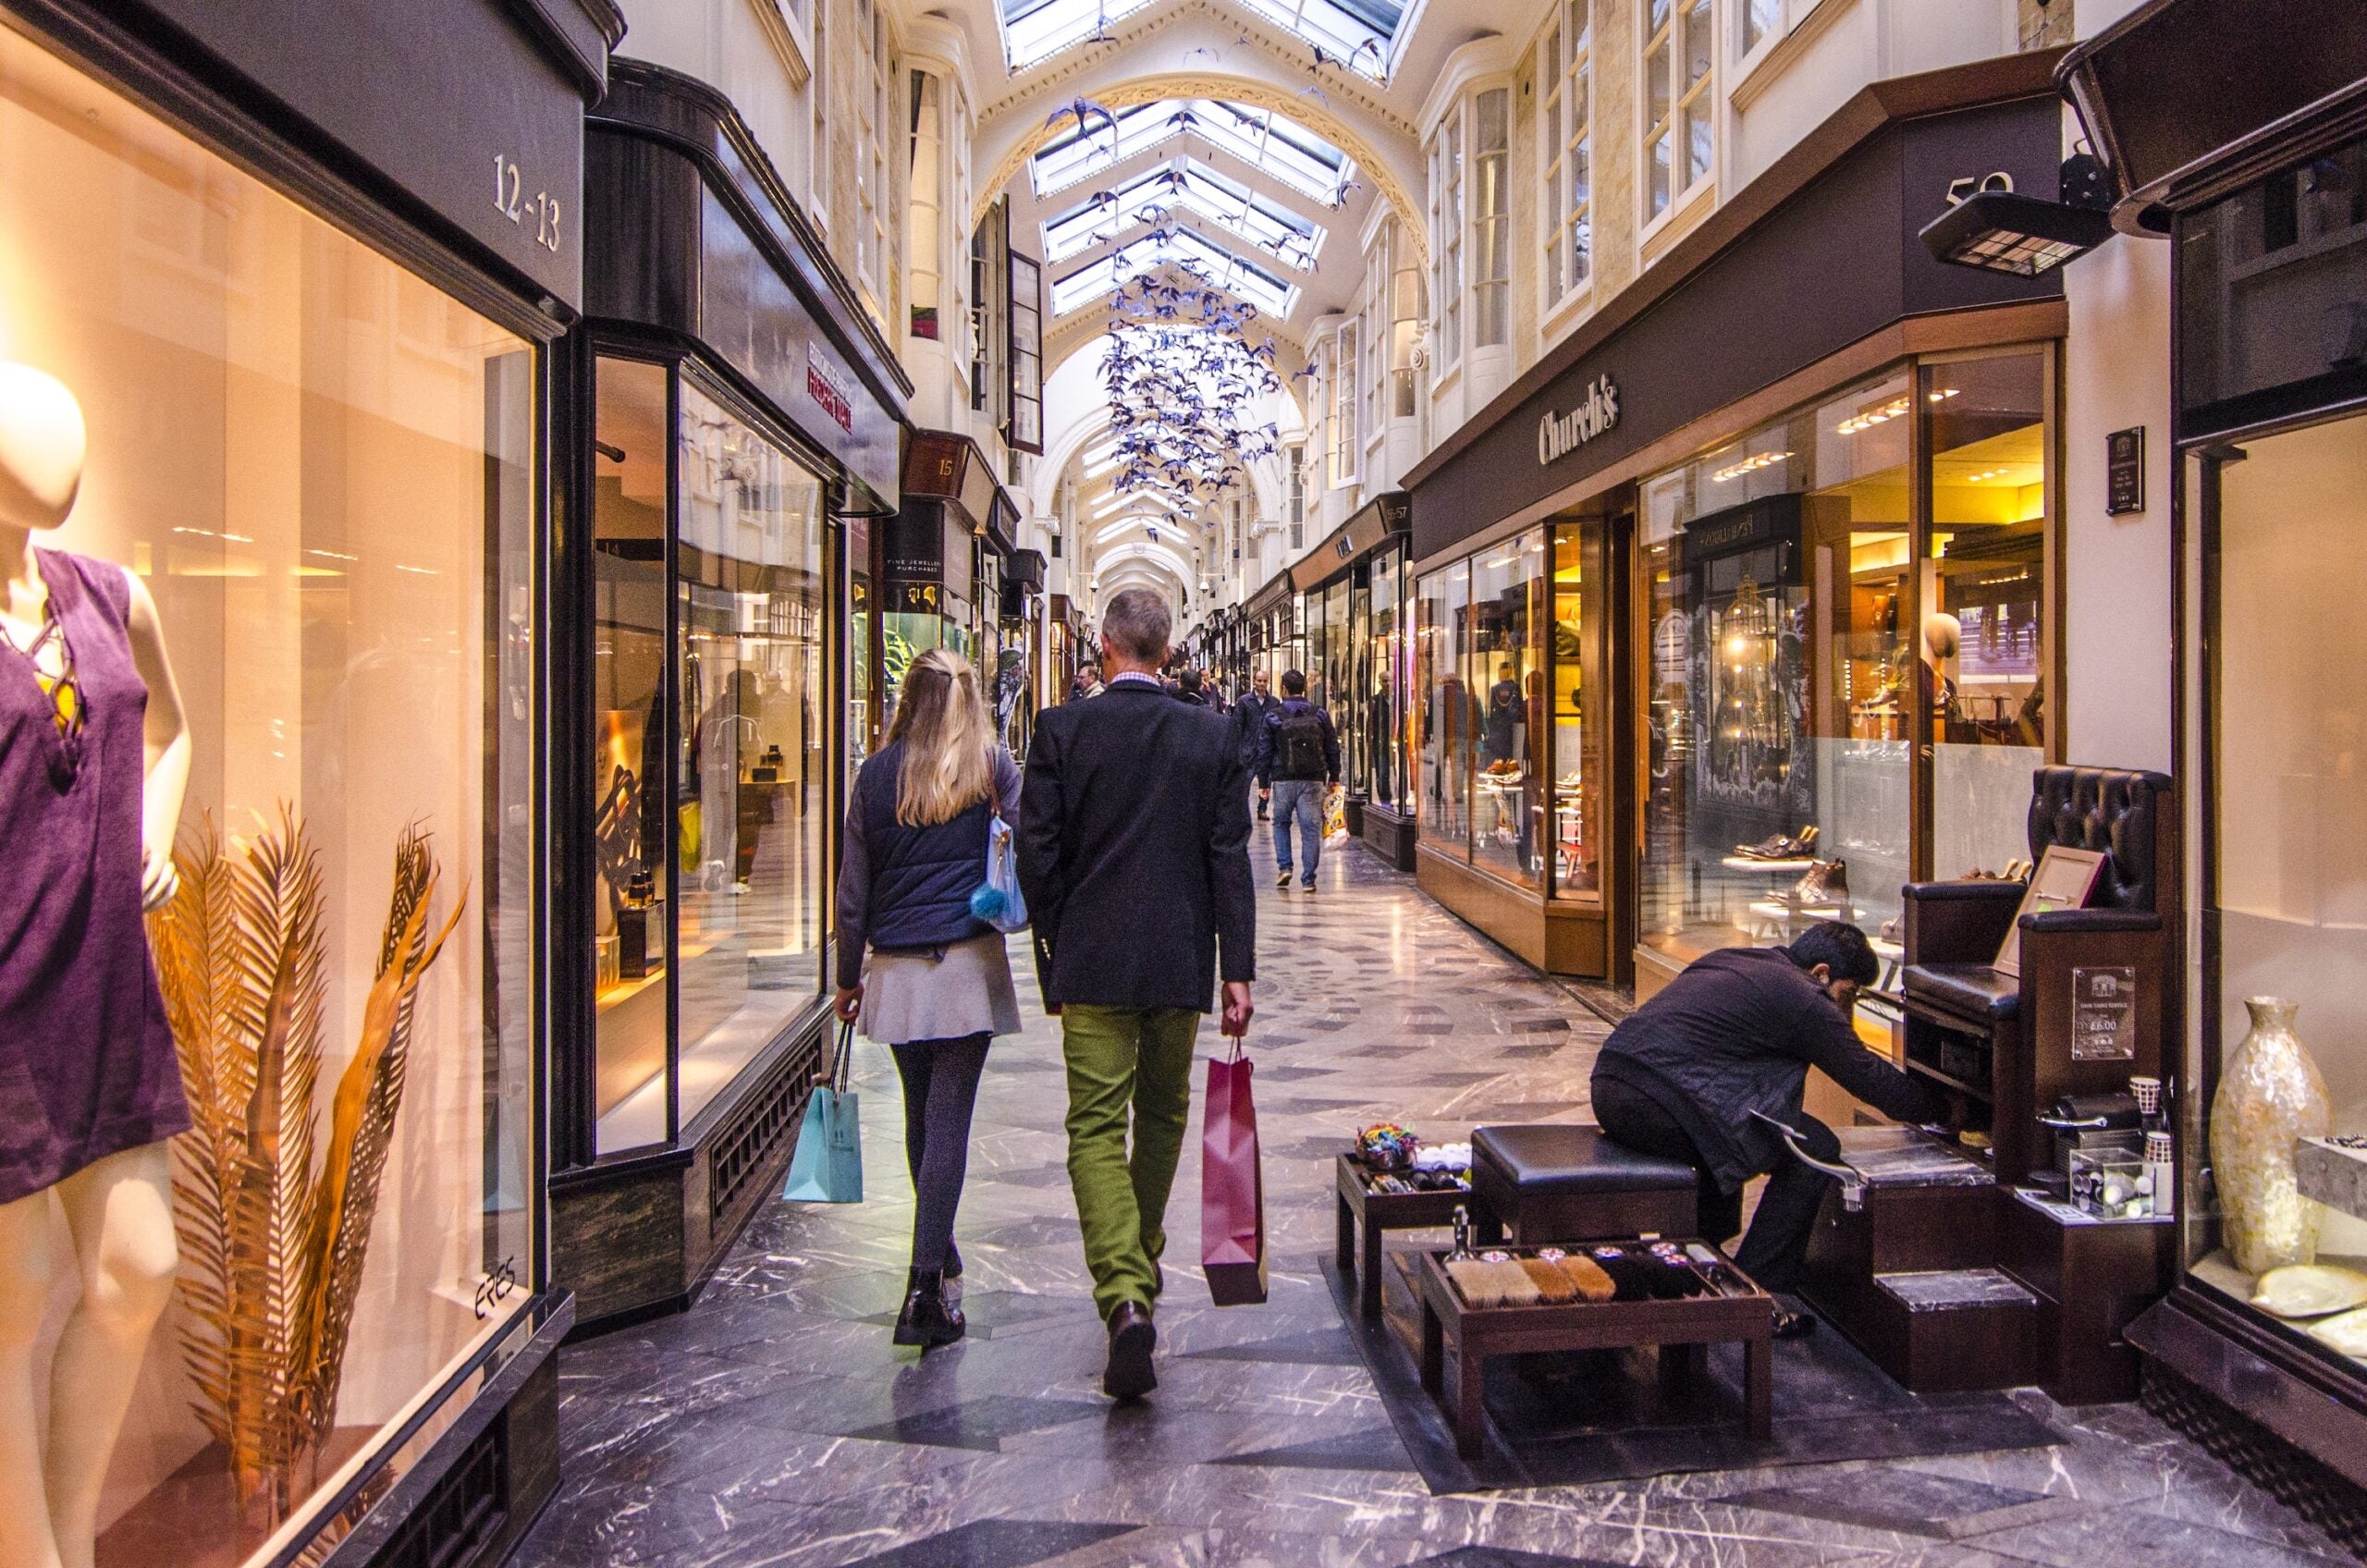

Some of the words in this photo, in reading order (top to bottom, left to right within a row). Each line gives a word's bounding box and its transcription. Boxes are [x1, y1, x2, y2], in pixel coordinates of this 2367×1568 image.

[494, 153, 560, 252] 12-13
[1539, 373, 1617, 465] Church's
[938, 459, 953, 477] 15
